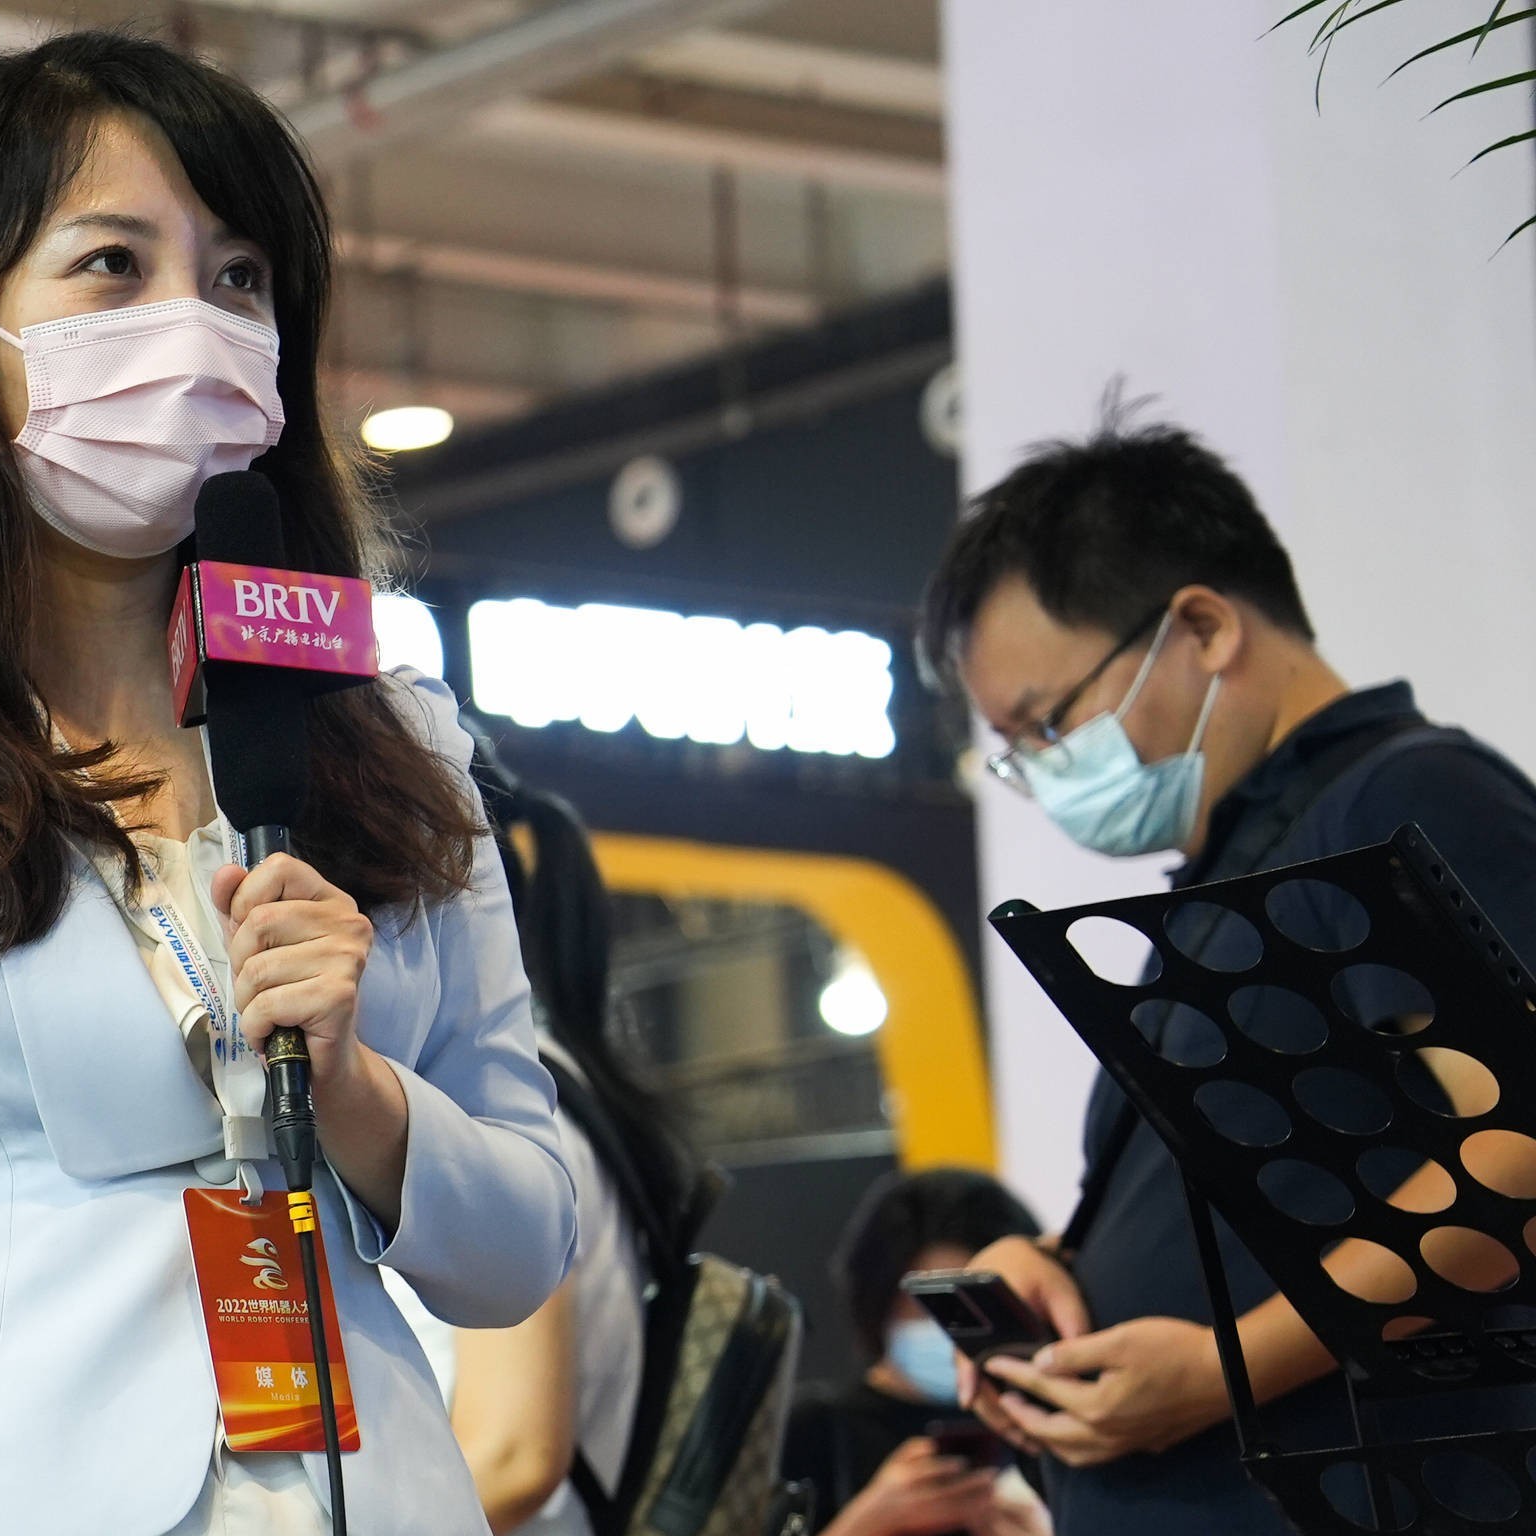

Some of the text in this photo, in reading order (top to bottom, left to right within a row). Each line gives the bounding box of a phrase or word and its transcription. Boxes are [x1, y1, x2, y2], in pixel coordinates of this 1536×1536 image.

[233, 579, 341, 627] BRTV
[241, 625, 344, 650] 北京广播电视台
[165, 903, 202, 962] CONFERENCE
[216, 1298, 309, 1314] 2022世界机器人大
[219, 1315, 309, 1324] WORLD ROBOT CONFERE
